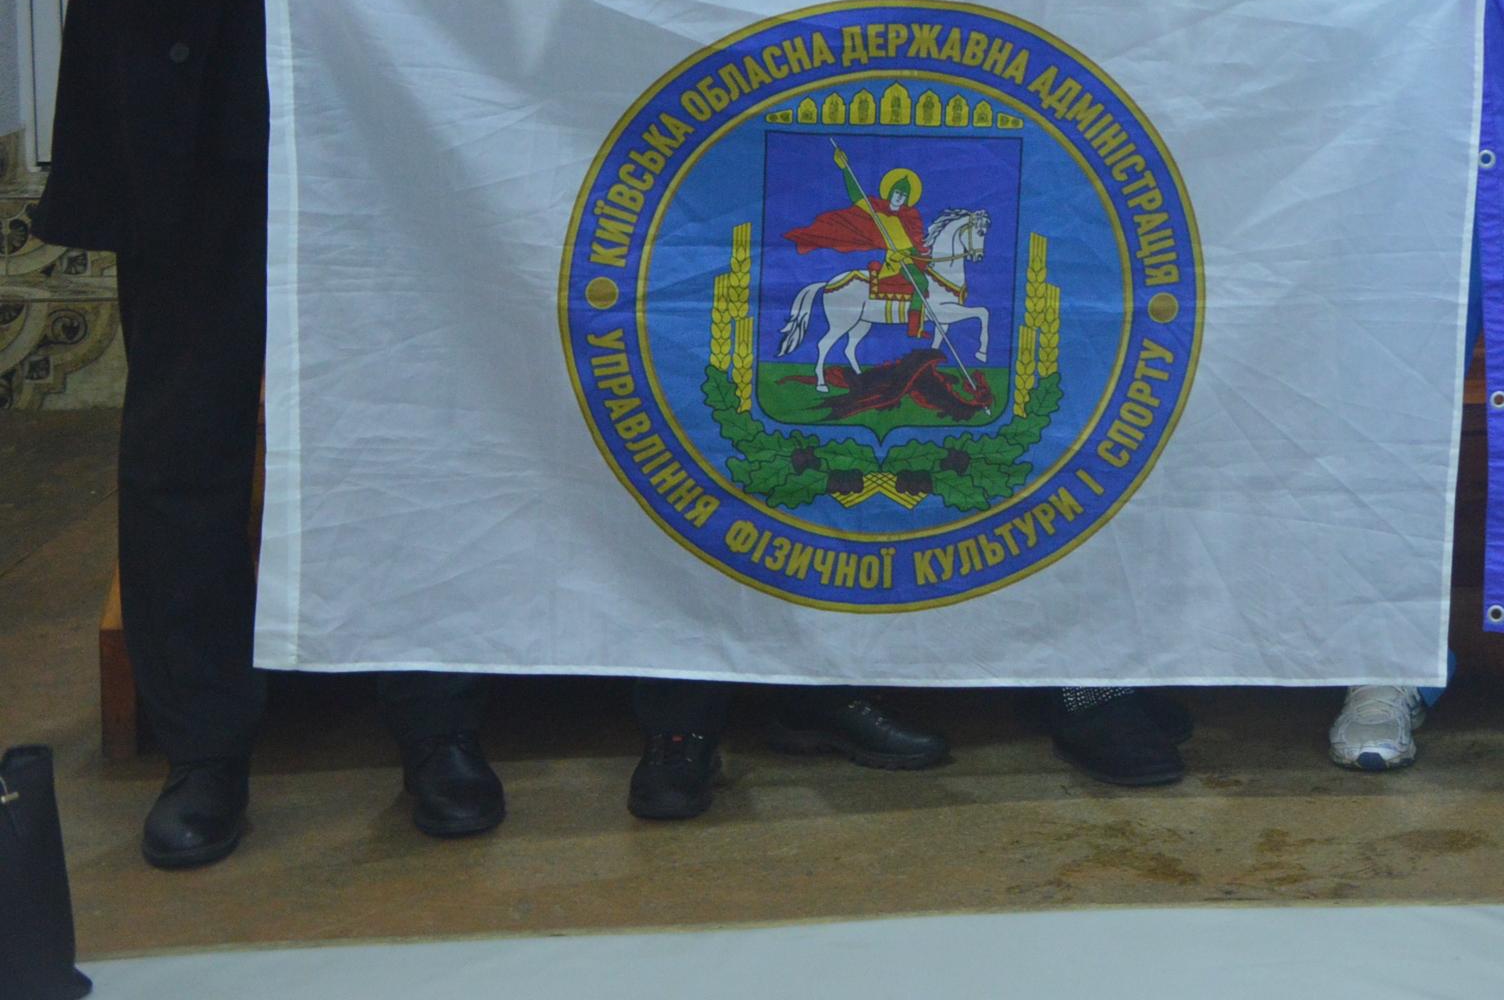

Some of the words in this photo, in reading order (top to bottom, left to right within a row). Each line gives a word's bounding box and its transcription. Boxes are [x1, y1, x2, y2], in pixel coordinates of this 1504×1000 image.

[589, 115, 694, 268] КИЇВСЬКА
[681, 32, 835, 119] ОБЛАСНА
[841, 23, 1029, 84] ДЕРЖАВНА
[1028, 66, 1180, 286] АДМІНІСТРАЦІЯ
[588, 329, 720, 527] УПРАВЛІННЯ
[725, 520, 896, 590] ФІЗИЧНОЇ
[914, 489, 1083, 585] КУЛЬТУРИ
[1077, 469, 1105, 495] І
[1097, 338, 1174, 467] СПОРТУ
